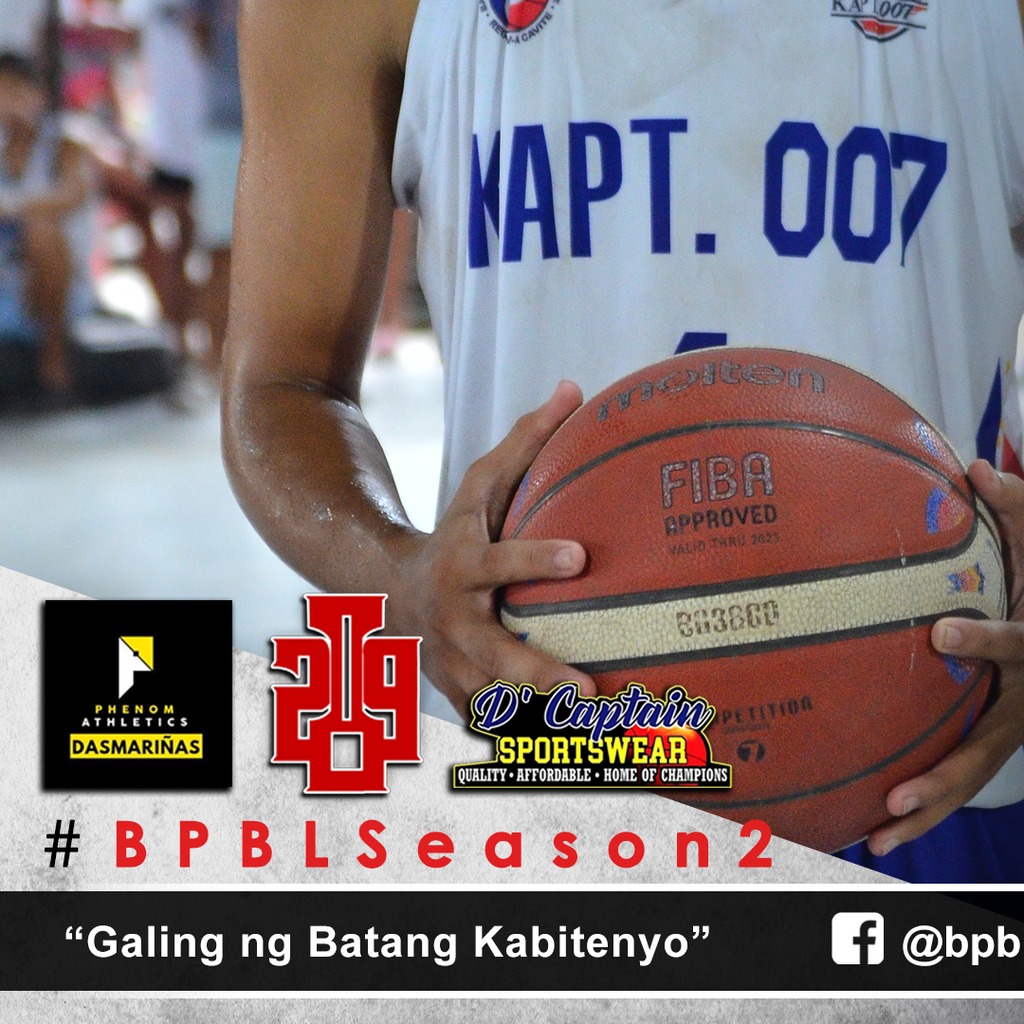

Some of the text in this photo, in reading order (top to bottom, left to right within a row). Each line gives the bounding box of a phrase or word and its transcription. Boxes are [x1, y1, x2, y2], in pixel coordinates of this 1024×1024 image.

[468, 118, 948, 268] KAPT. 007
[597, 359, 826, 423] molten
[660, 451, 775, 510] FIBA
[663, 503, 778, 537] APPROVED
